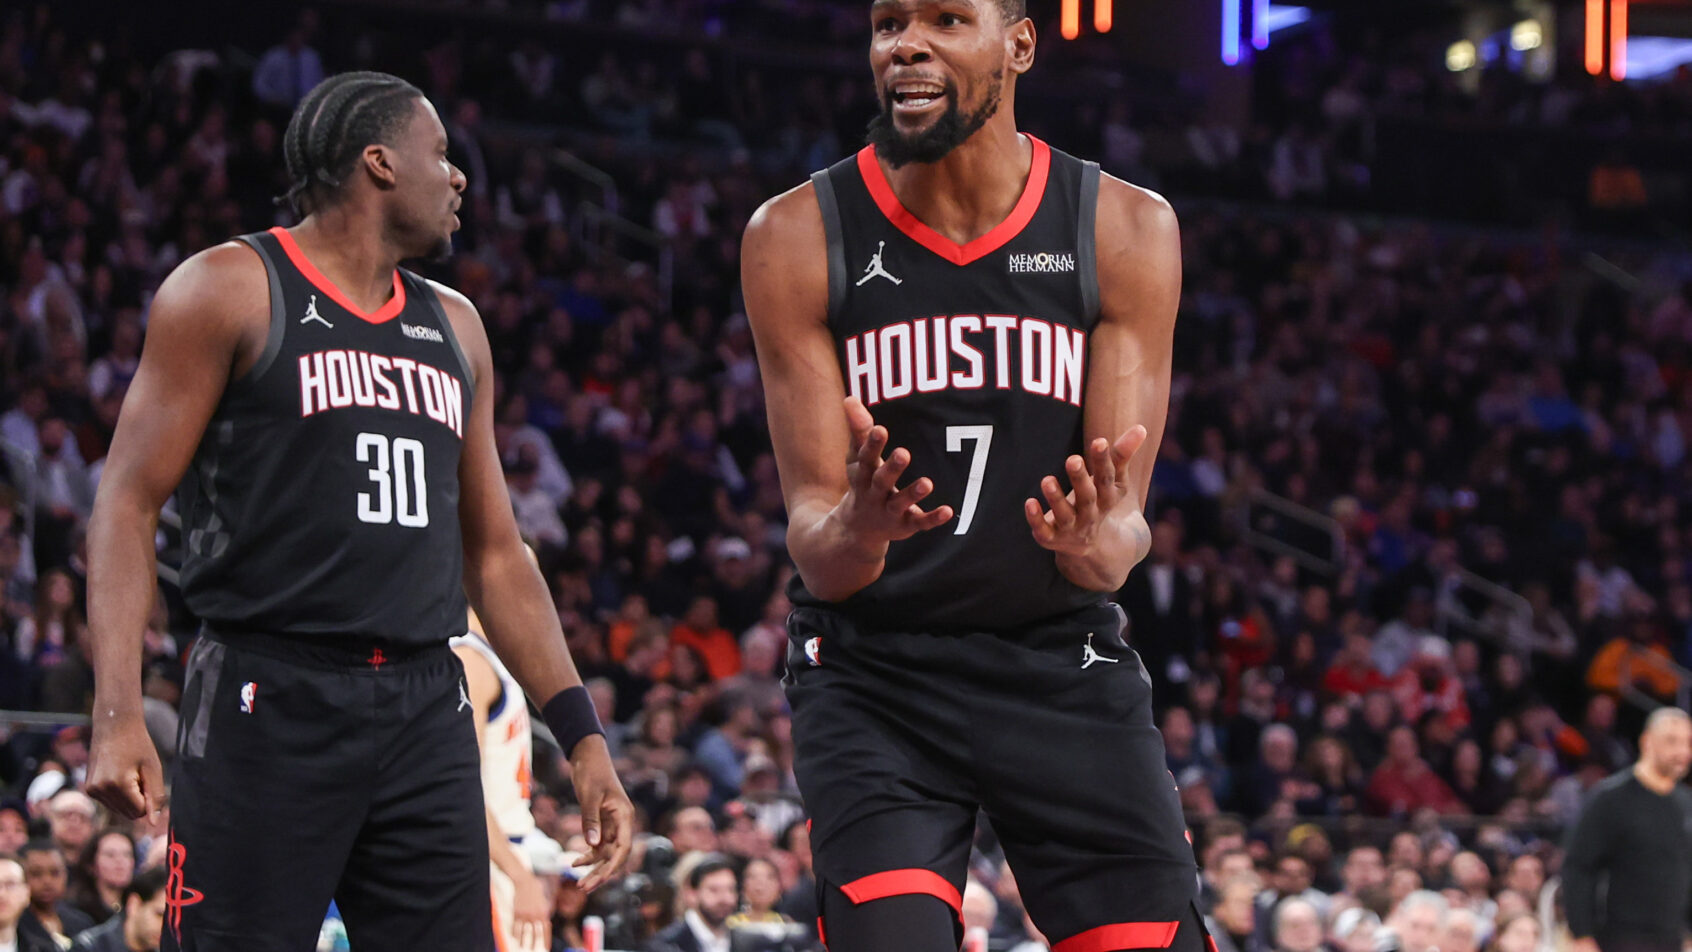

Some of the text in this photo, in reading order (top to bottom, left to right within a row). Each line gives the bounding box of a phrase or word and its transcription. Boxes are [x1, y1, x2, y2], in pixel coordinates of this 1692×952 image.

[1009, 252, 1074, 265] MEMORIAL
[1009, 262, 1074, 272] HERMANN
[298, 350, 463, 440] HOUSTON
[845, 314, 1086, 407] HOUSTON
[356, 432, 429, 528] 30
[946, 425, 994, 535] 7
